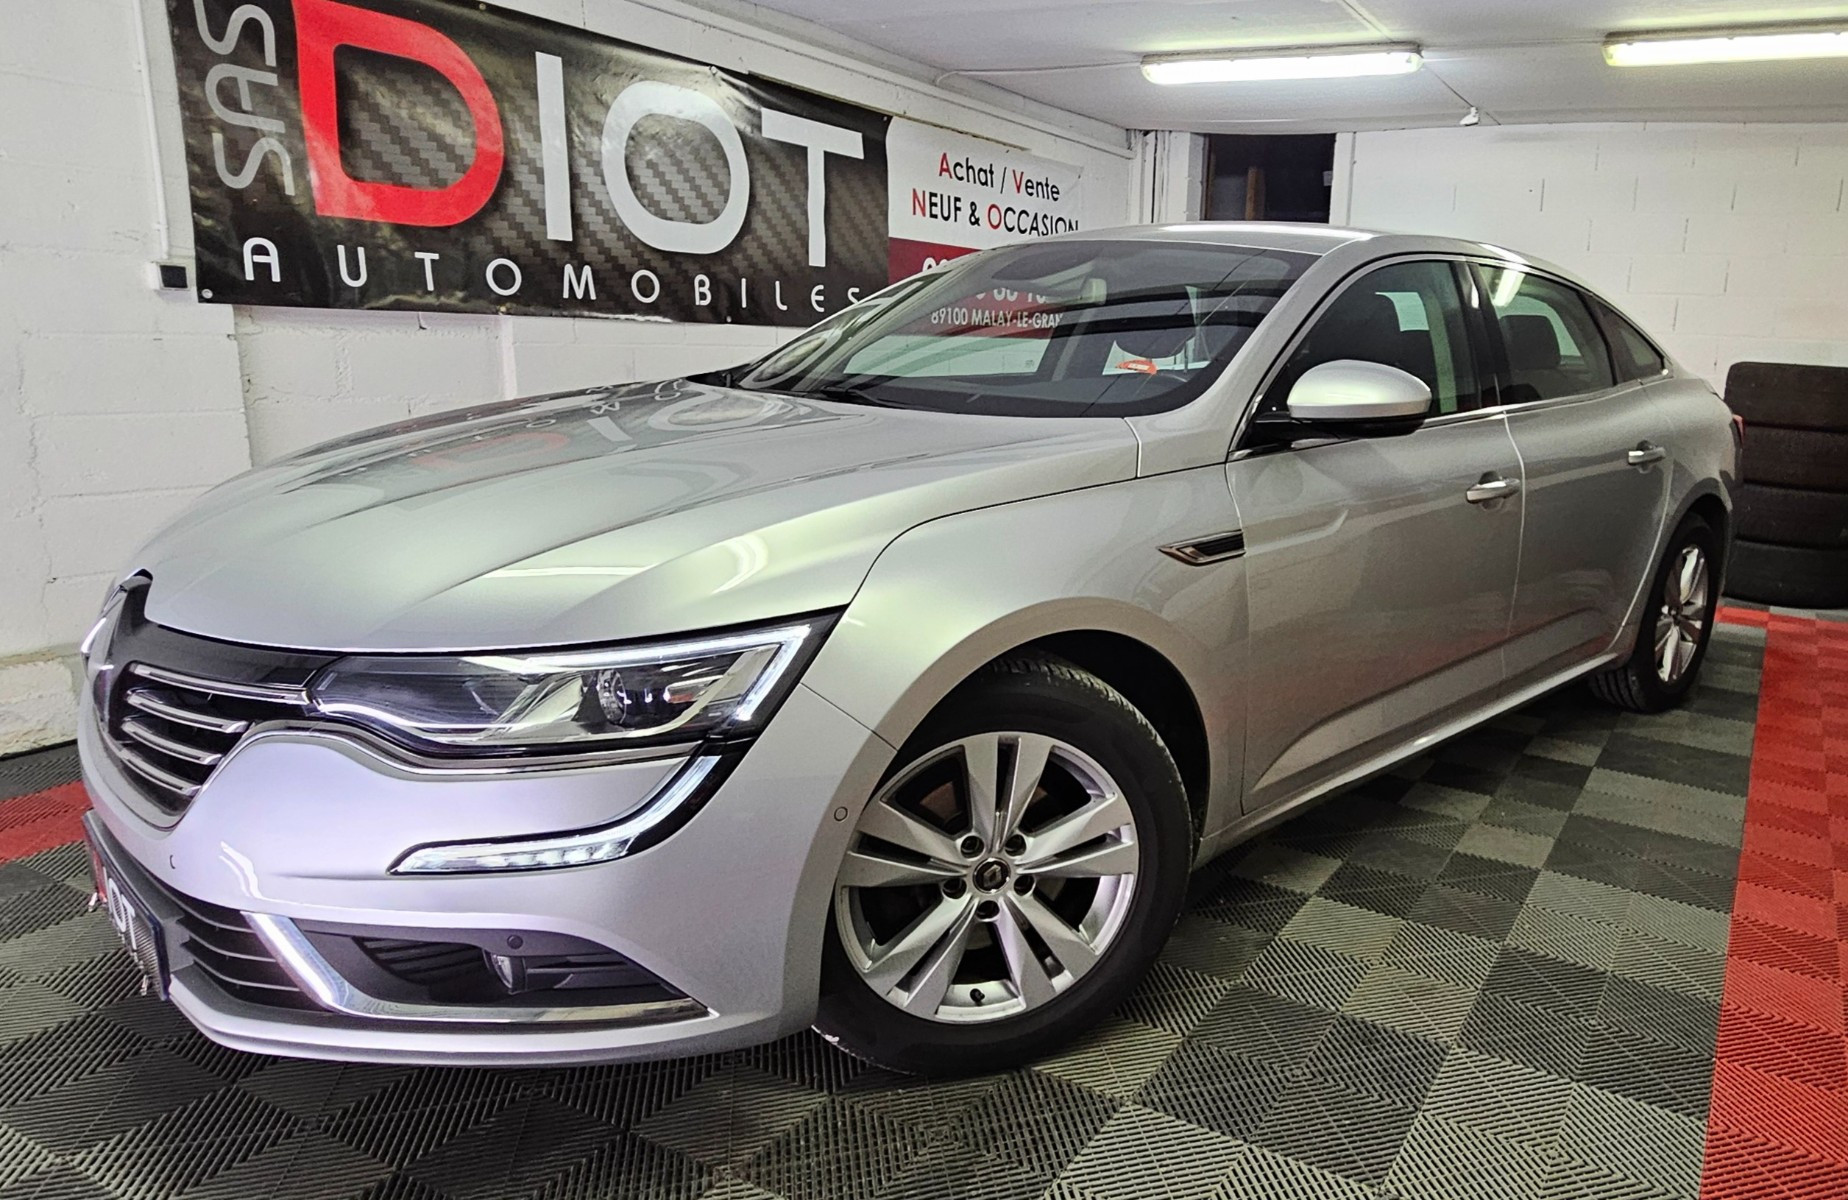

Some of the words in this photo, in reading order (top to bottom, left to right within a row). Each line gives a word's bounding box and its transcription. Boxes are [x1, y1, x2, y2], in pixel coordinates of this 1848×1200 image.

[193, 0, 295, 196] SAS
[290, 0, 865, 268] DIOT
[912, 188, 962, 223] NEUF
[968, 201, 980, 227] &
[938, 152, 995, 188] Achat
[1000, 166, 1007, 194] /
[1012, 168, 1060, 202] Vente
